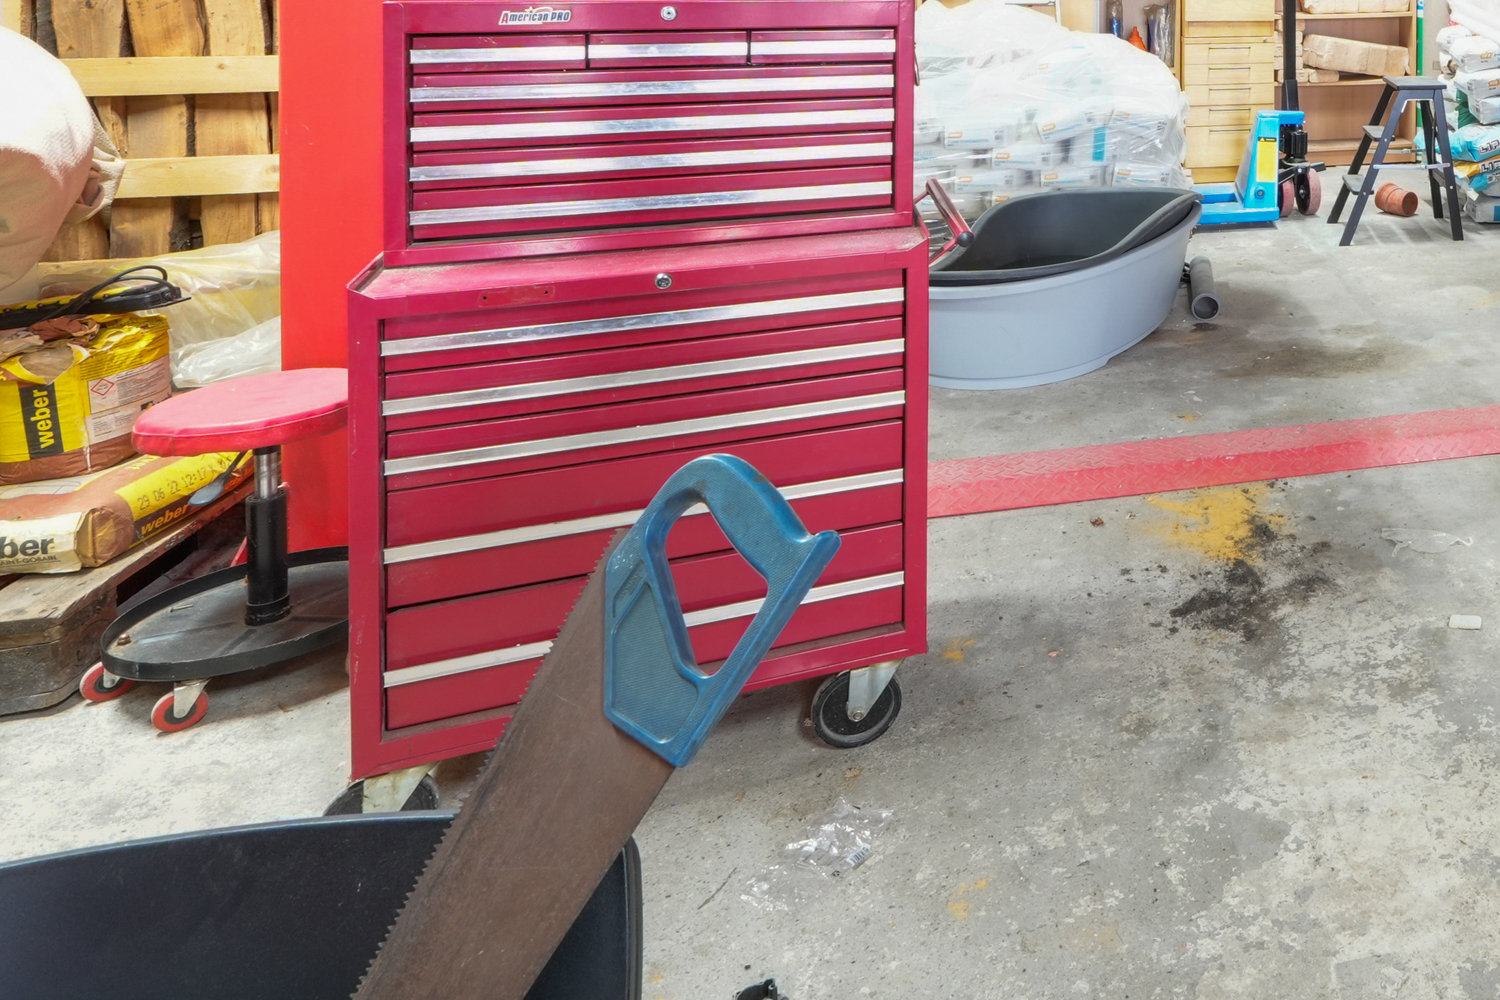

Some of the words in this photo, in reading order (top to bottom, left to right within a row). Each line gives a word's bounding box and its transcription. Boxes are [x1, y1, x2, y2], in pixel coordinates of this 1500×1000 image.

[501, 11, 549, 24] American
[551, 11, 570, 21] PRO
[30, 388, 55, 449] weber
[141, 503, 189, 535] weber
